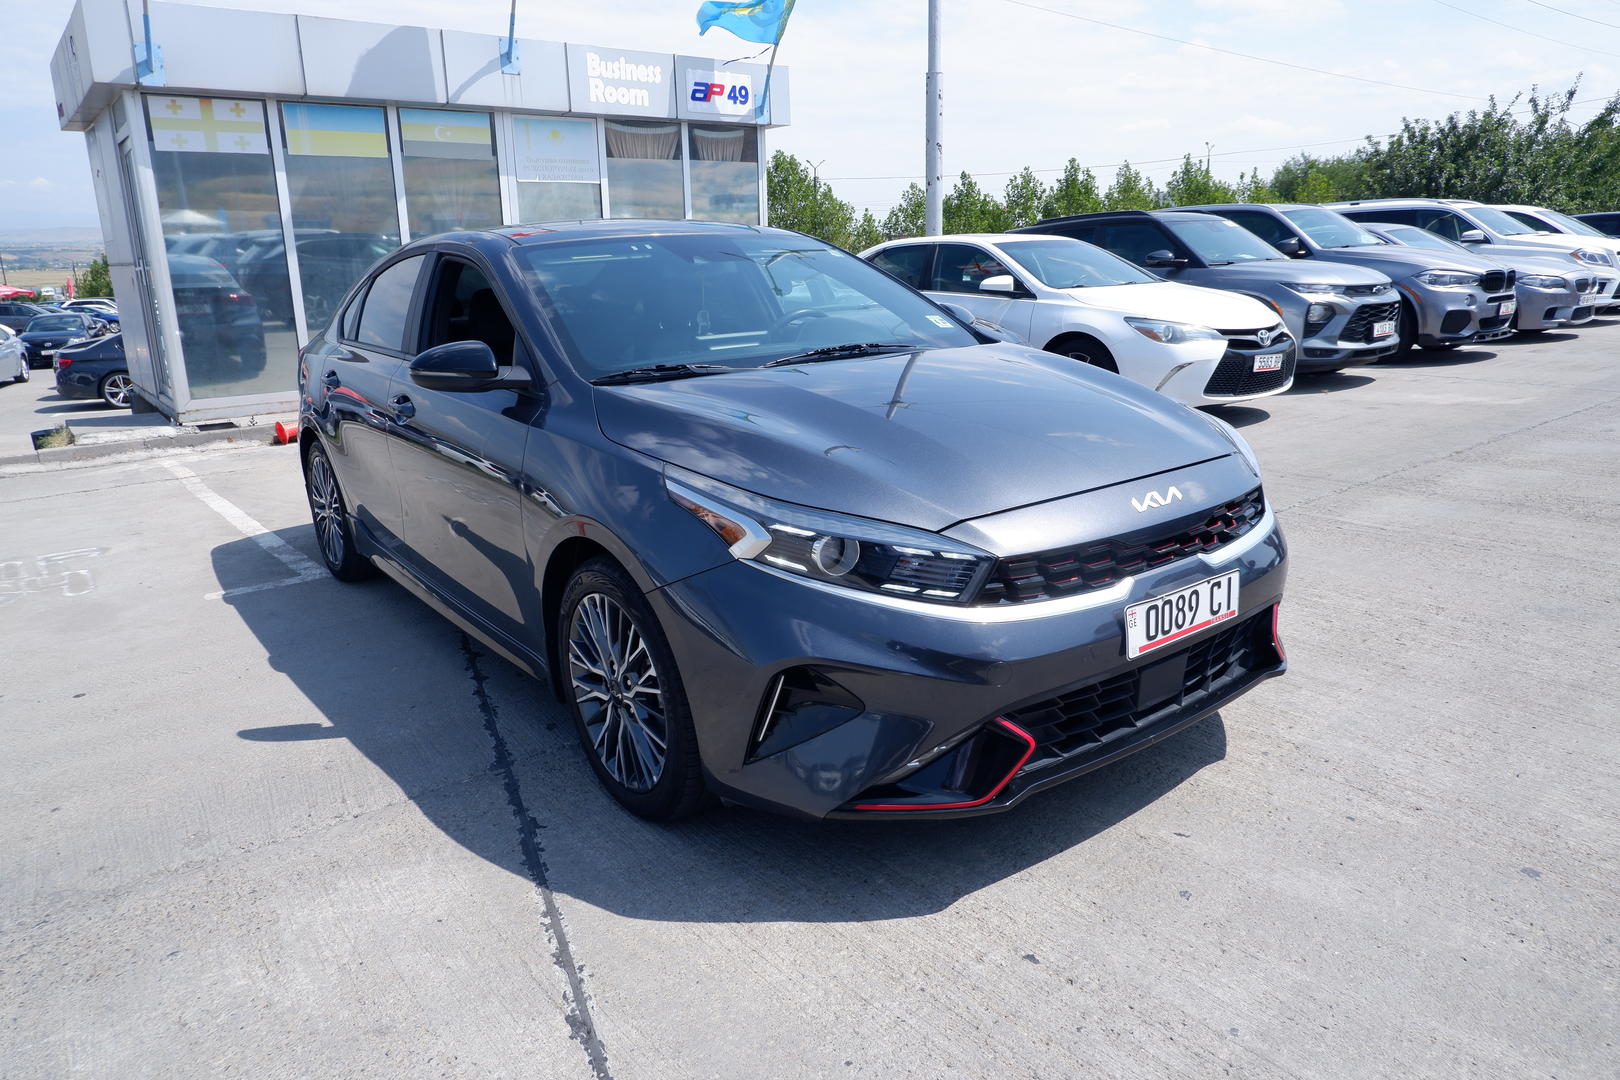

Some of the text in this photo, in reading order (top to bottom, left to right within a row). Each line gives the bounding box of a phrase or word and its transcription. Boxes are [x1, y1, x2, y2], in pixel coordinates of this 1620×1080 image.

[586, 52, 662, 84] Business
[589, 77, 650, 107] Room
[727, 85, 749, 105] 49
[1131, 485, 1183, 513] KIA
[1145, 576, 1232, 641] 0089 CI
